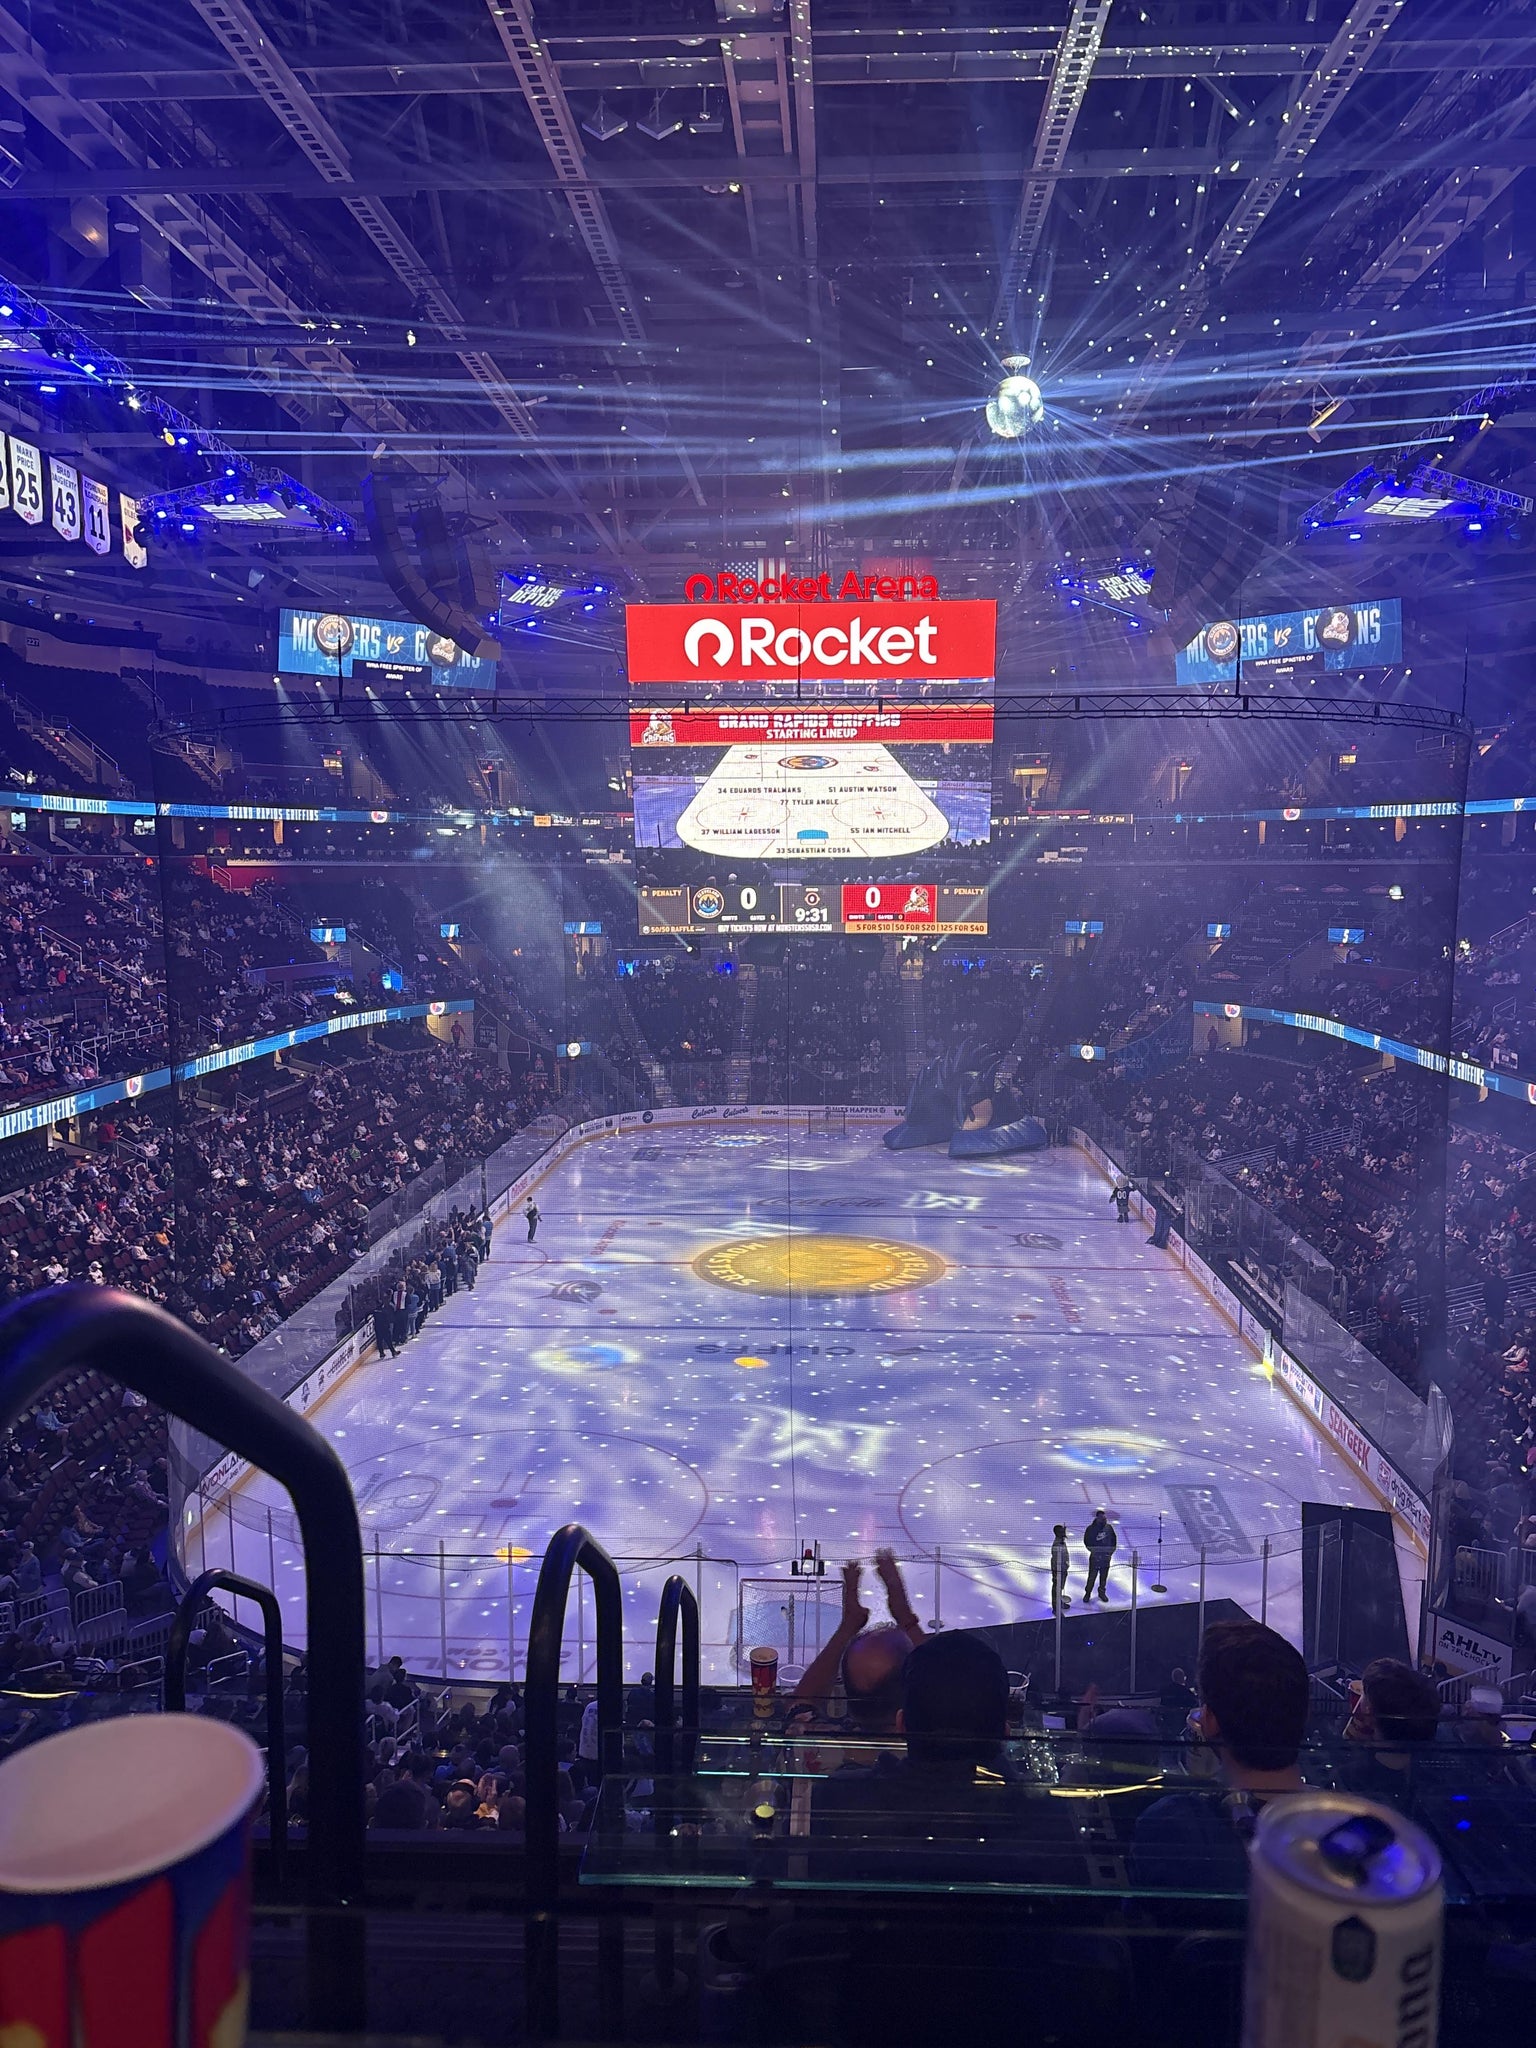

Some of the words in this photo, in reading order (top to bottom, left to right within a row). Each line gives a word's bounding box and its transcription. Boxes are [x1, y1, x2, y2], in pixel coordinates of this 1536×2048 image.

[16, 444, 33, 459] MARK
[17, 455, 34, 470] PRICE
[57, 465, 71, 479] BRAD
[15, 468, 40, 510] 25
[55, 488, 76, 527] 43
[89, 505, 106, 541] 11
[717, 571, 832, 602] Rocket
[838, 570, 938, 600] Arena
[1097, 576, 1125, 588] FEAR
[1122, 572, 1142, 581] THE
[519, 583, 547, 594] FEAR
[546, 588, 566, 596] THE
[1105, 580, 1152, 601] DEPTHS
[507, 590, 560, 608] DEPTHS
[740, 615, 938, 667] Rocket
[718, 714, 769, 729] GRAND
[773, 714, 829, 728] RAPIDS
[832, 714, 901, 727] GRIFFINS
[766, 729, 818, 739] STARTING
[819, 728, 858, 739] LINEUP
[42, 794, 74, 811] CLEVELAND
[1370, 804, 1412, 818] CLEVELAND
[1415, 802, 1457, 816] MONSTERS
[228, 806, 253, 819] GRAND
[256, 807, 283, 820] RAPIDS
[285, 809, 319, 821] GRIFFINS
[1099, 815, 1114, 823] 6:57
[652, 889, 682, 897] PENALTY
[740, 887, 757, 910] 0
[865, 886, 881, 908] 0
[794, 908, 828, 922] 9:31
[730, 924, 753, 932] TICKETS
[970, 924, 985, 932] $40
[36, 1095, 77, 1127] GRIFFINS
[708, 1243, 768, 1287] MONSTERS
[868, 1242, 929, 1291] CLEVELAND
[1328, 1405, 1371, 1472] SEATGEEK
[1438, 1640, 1449, 1649] ON
